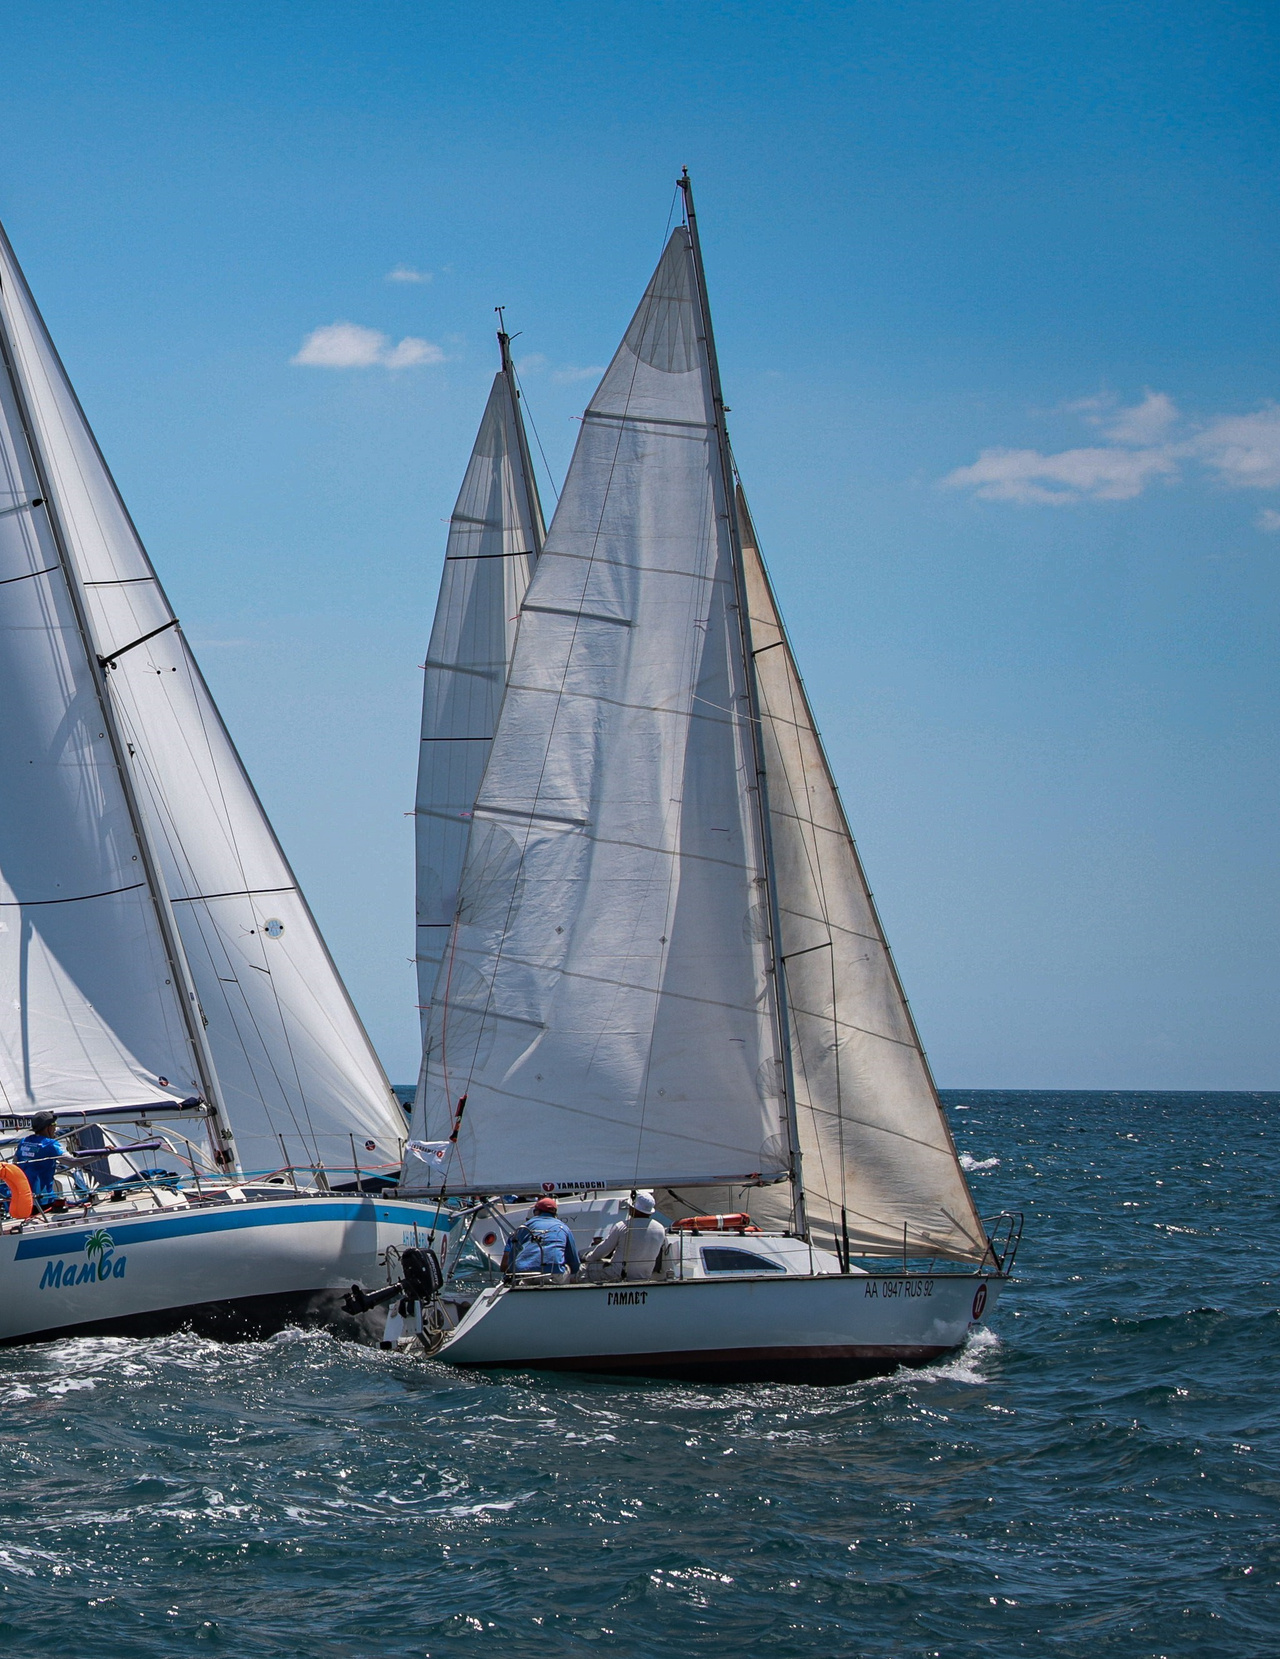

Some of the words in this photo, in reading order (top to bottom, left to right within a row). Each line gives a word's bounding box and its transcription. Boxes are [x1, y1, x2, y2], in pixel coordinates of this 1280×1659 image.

[0, 1119, 32, 1128] YAMAGUC
[557, 1181, 605, 1190] YAMAGUCHI
[39, 1248, 127, 1290] Мамба
[864, 1281, 879, 1298] AA
[882, 1281, 904, 1298] 0947
[904, 1280, 923, 1298] RUS
[923, 1280, 934, 1297] 92
[607, 1291, 648, 1306] ГАМЛЕТ
